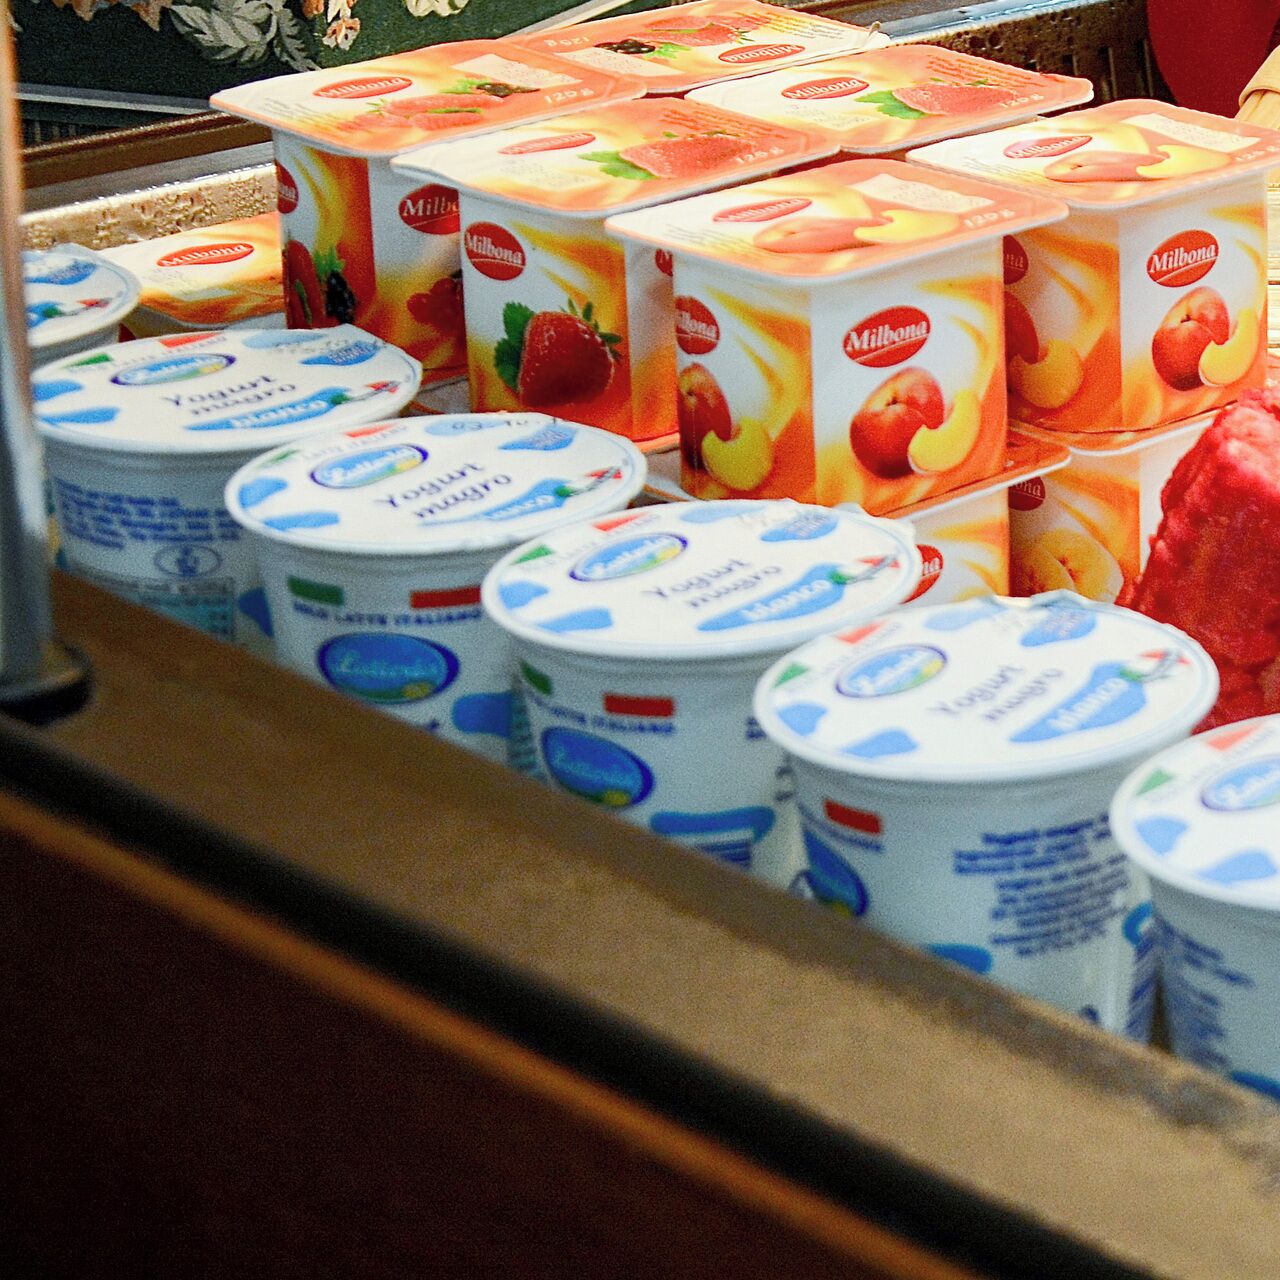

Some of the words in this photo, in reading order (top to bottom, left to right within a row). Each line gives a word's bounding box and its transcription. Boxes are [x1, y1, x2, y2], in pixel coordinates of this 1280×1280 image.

[725, 44, 800, 64] Milbona
[316, 77, 405, 98] Milbona
[544, 89, 581, 104] 125
[786, 77, 863, 100] Milbona
[466, 230, 523, 266] Milbona
[1149, 242, 1218, 274] Milbona
[846, 320, 929, 354] Milbona
[161, 374, 277, 408] Yogurt
[189, 381, 297, 417] magro
[229, 398, 328, 431] bianco
[375, 460, 486, 508] Yogurt
[413, 472, 513, 520] magro
[641, 555, 754, 601] Yogurt
[687, 562, 783, 610] magro
[739, 579, 831, 622] bianco
[929, 662, 1024, 717] Yogurt
